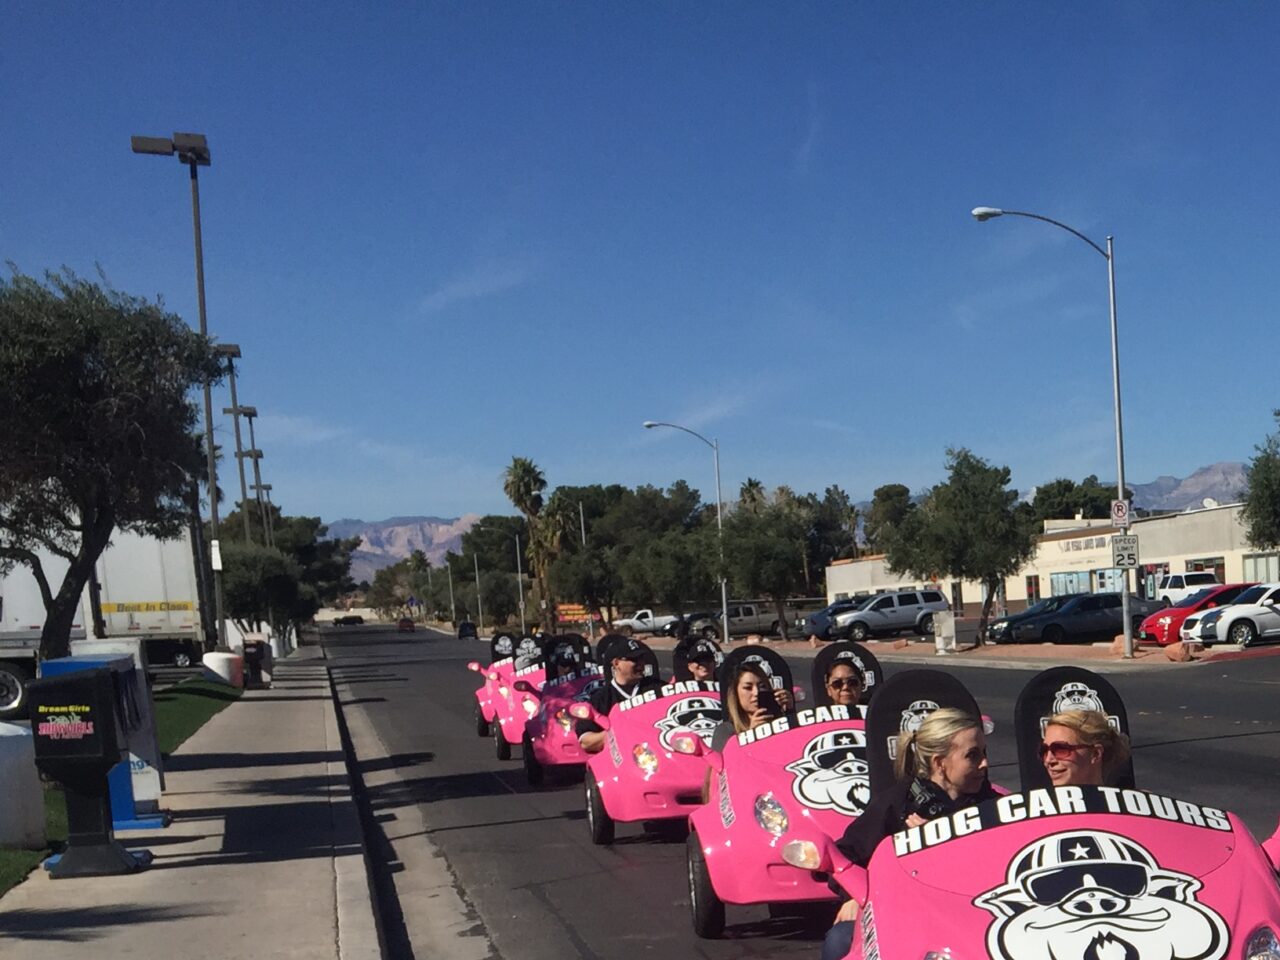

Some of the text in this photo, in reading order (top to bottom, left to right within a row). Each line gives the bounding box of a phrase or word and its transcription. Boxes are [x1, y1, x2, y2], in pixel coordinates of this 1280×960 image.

[1116, 553, 1136, 566] 25
[116, 602, 189, 612] Best In Class
[516, 663, 540, 677] HOG
[619, 689, 657, 712] HOG
[661, 680, 700, 697] CAR
[738, 717, 790, 747] HOG
[796, 704, 850, 726] CAR
[894, 786, 1233, 857] HOG CAR TOURS
